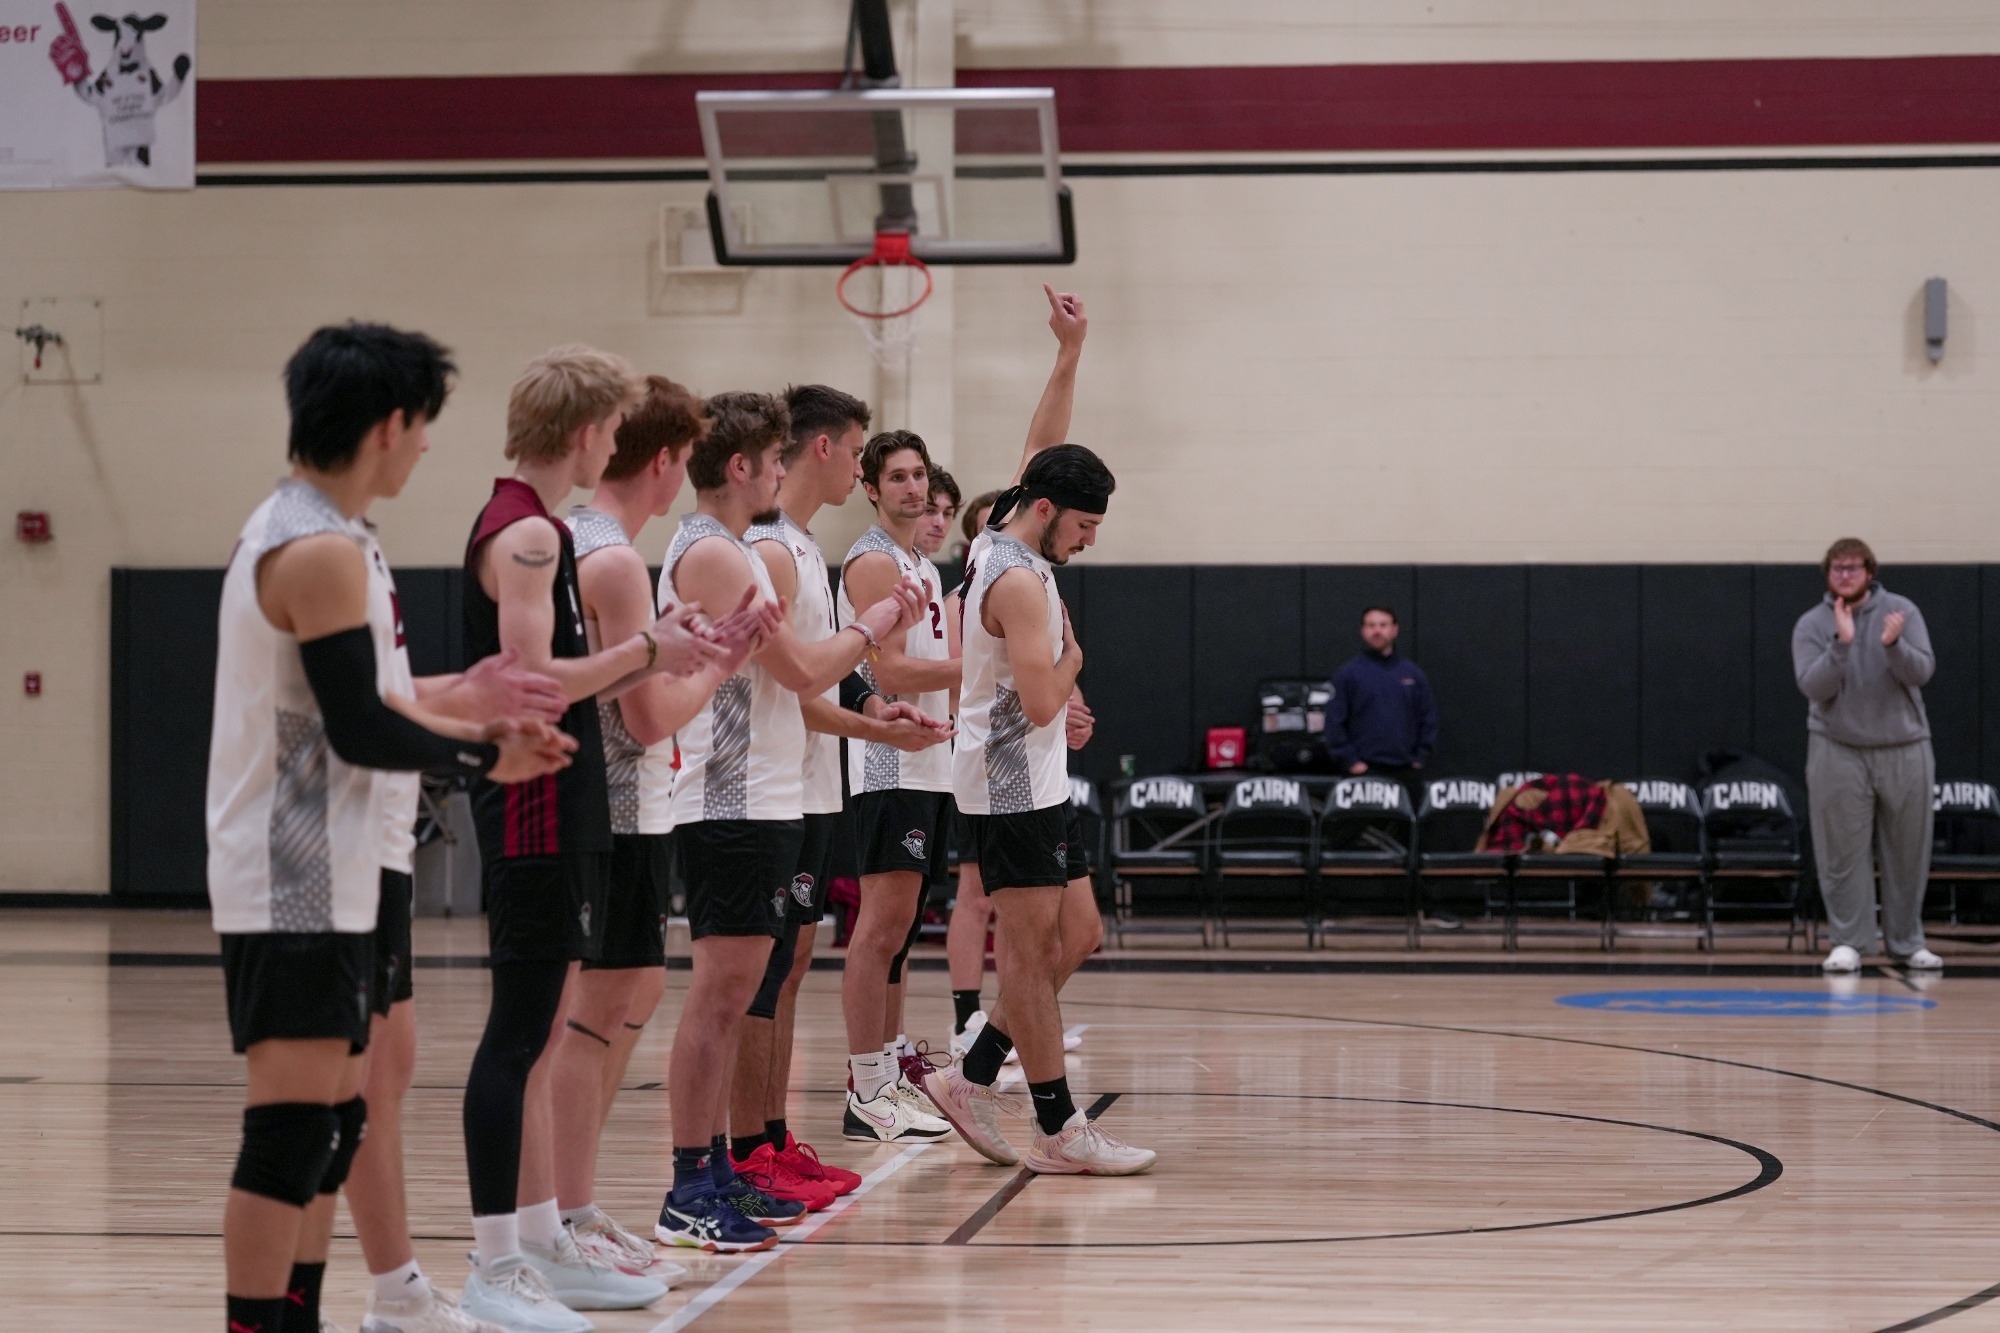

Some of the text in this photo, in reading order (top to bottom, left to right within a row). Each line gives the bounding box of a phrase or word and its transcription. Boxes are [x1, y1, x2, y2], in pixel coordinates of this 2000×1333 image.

[929, 602, 943, 639] 2
[1130, 780, 1194, 808] CAIRN
[1236, 779, 1299, 808] CAIRN
[1336, 781, 1400, 809] CAIRN
[1430, 781, 1496, 809] CAIRN
[1713, 781, 1778, 810] CAIRN
